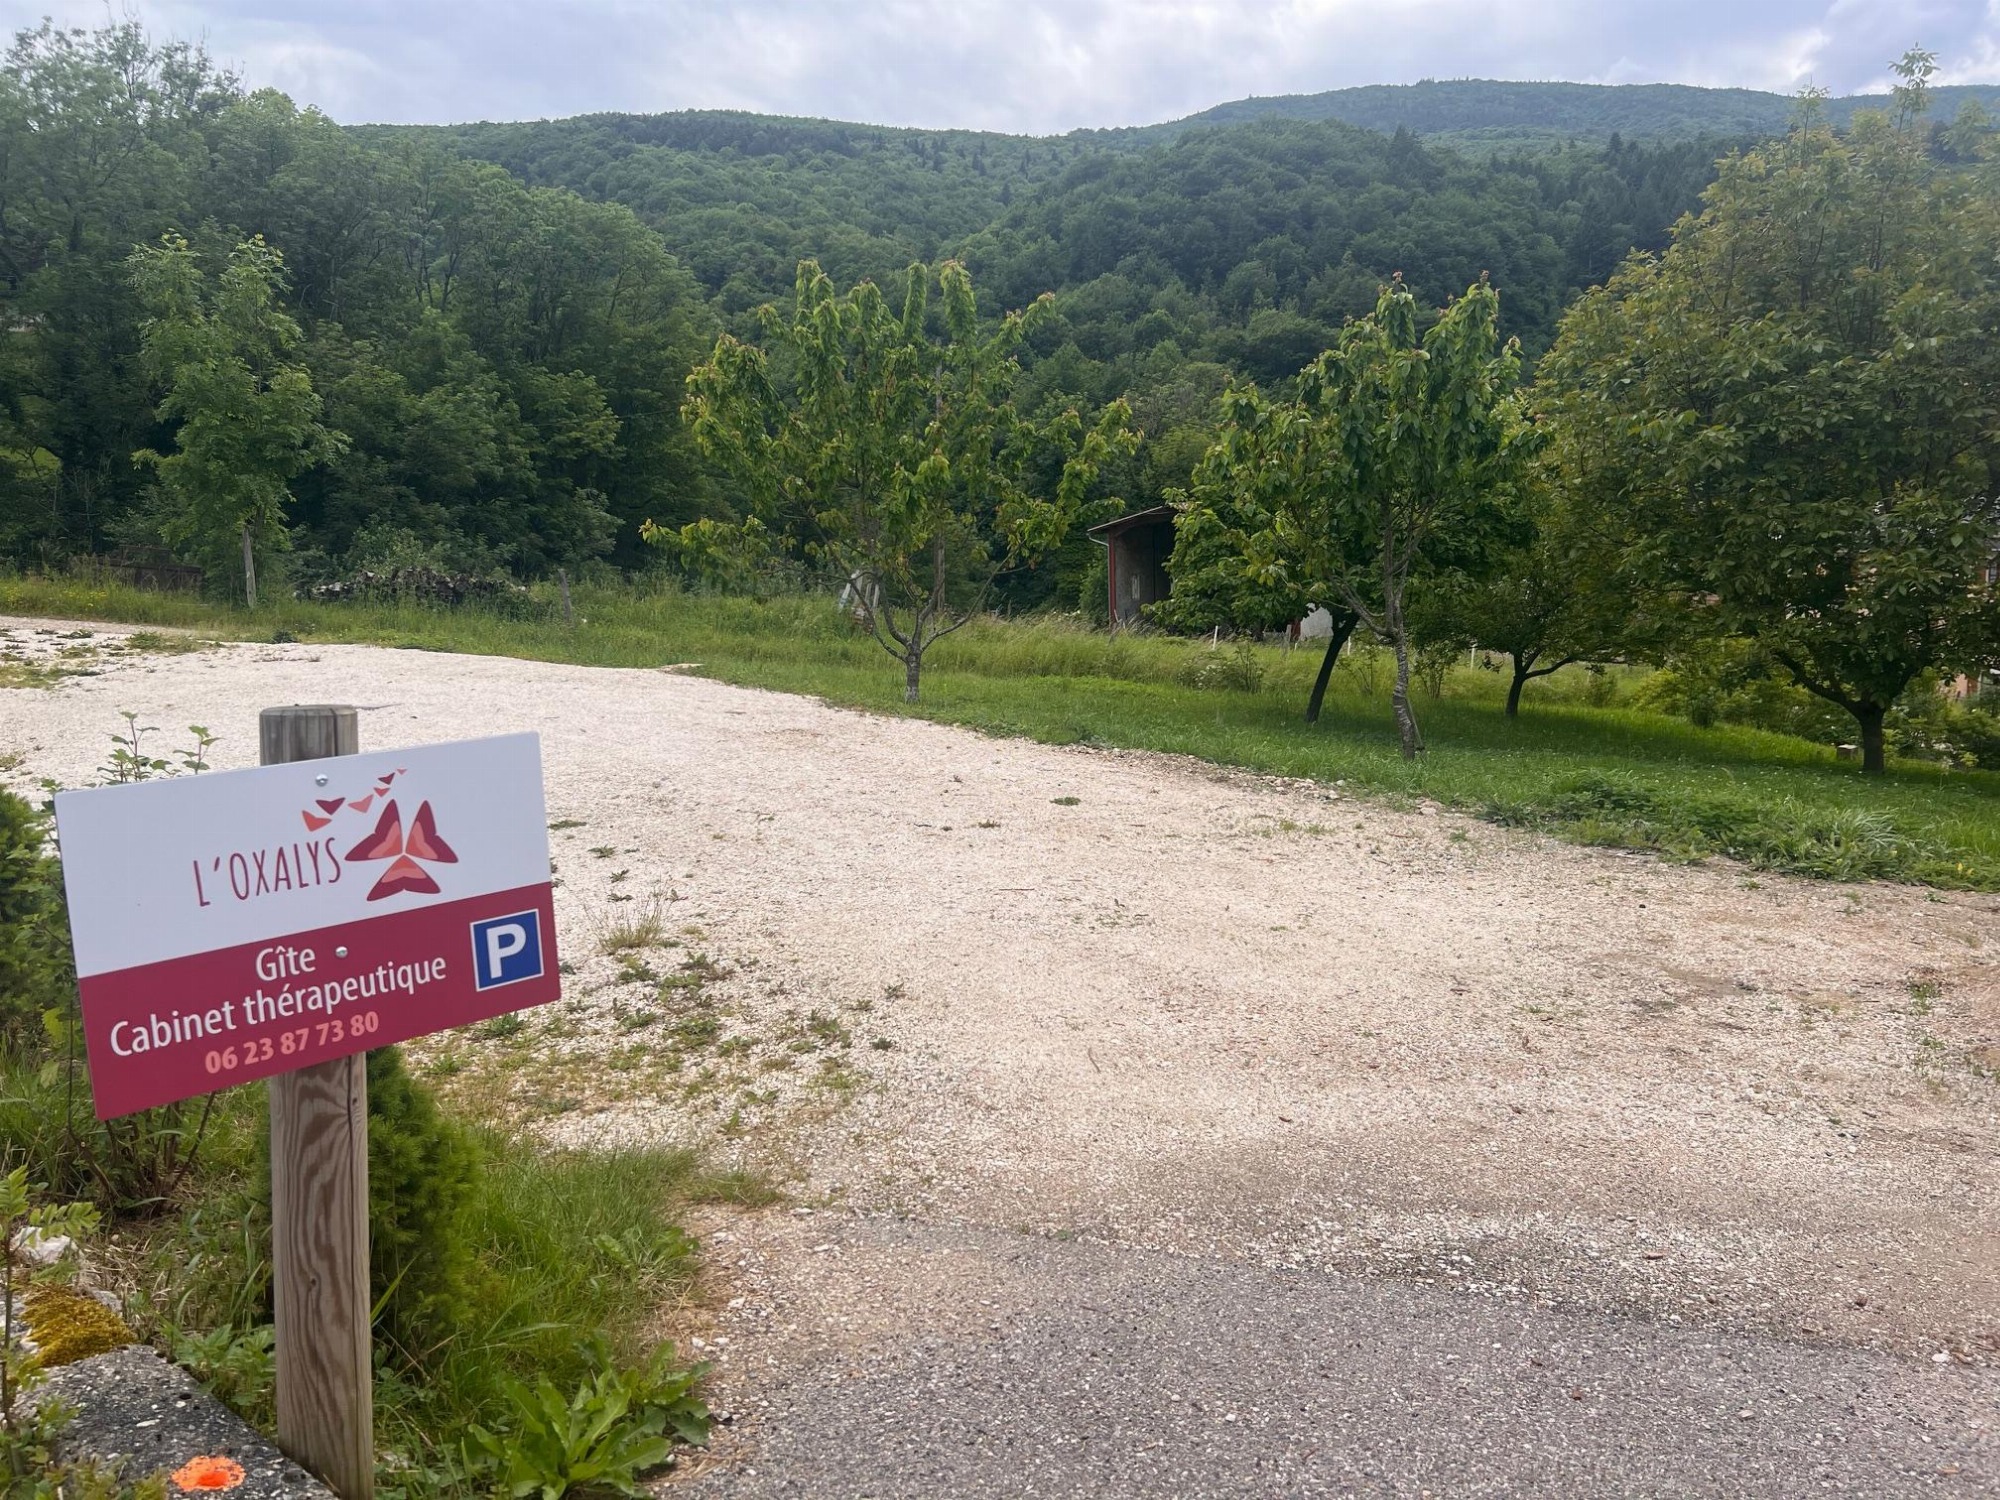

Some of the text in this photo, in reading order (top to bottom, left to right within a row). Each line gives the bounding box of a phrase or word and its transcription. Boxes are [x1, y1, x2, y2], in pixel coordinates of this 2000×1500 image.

[193, 837, 341, 907] L'OXALYS
[255, 945, 316, 982] Gîte
[487, 924, 527, 979] P
[110, 954, 447, 1058] Cabinet thérapeutique
[205, 1011, 379, 1074] 06 23 87 73 80
